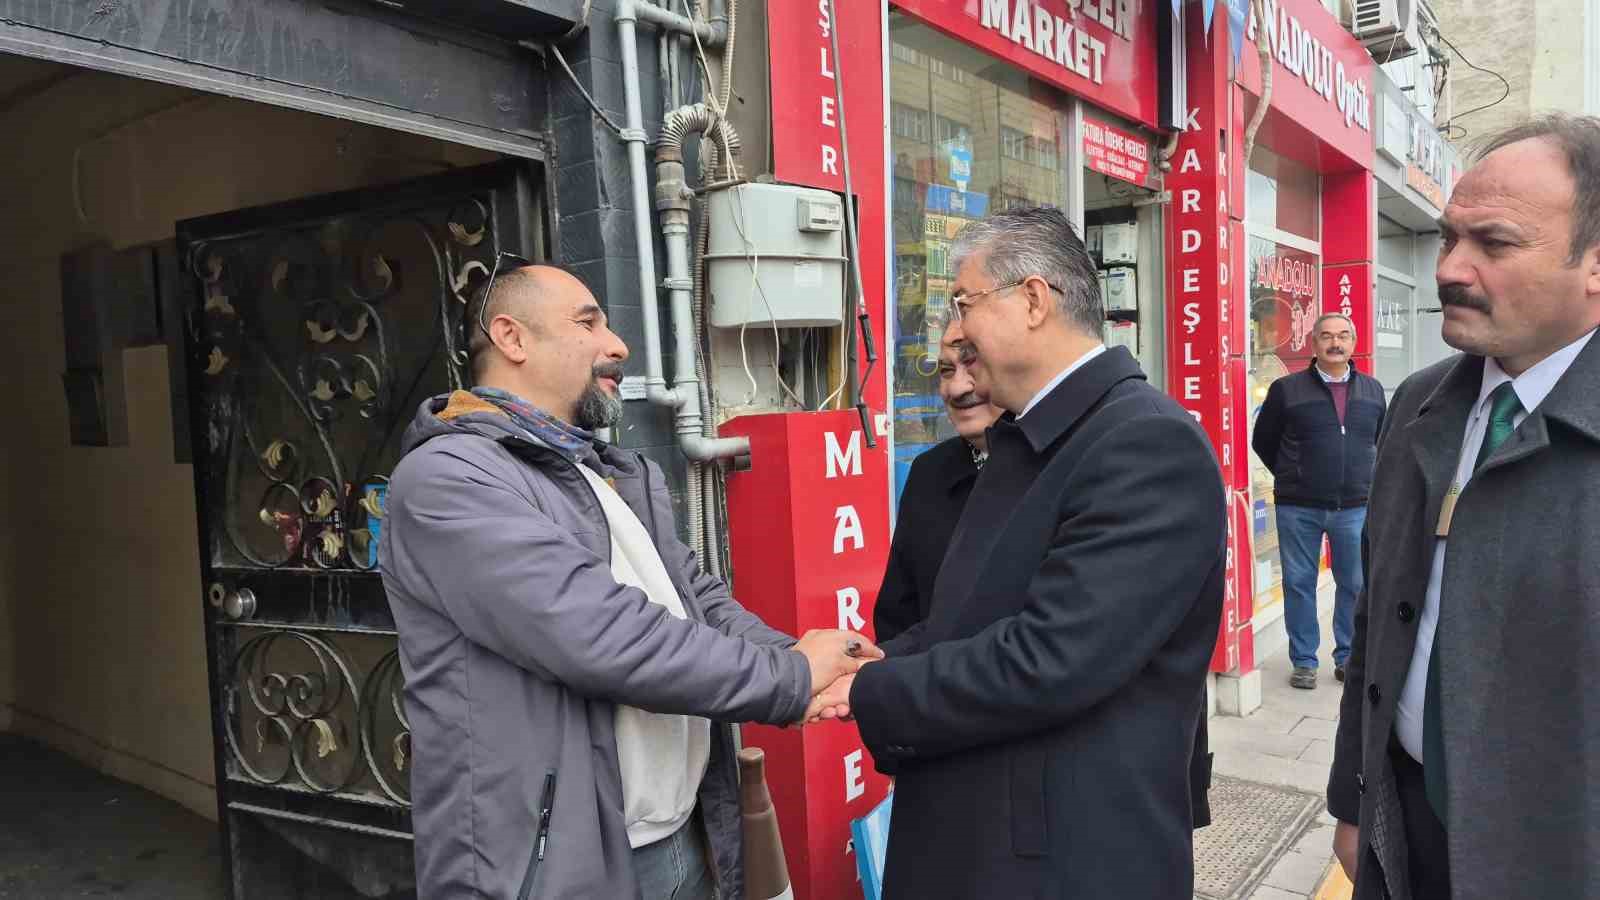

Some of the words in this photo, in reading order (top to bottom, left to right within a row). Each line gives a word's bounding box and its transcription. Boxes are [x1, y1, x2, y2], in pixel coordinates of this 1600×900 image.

[981, 0, 1106, 85] MARKET
[1180, 107, 1202, 423] KARDEŞLE
[1218, 152, 1231, 466] KARDEŞLER
[1256, 255, 1315, 297] ANADOLU
